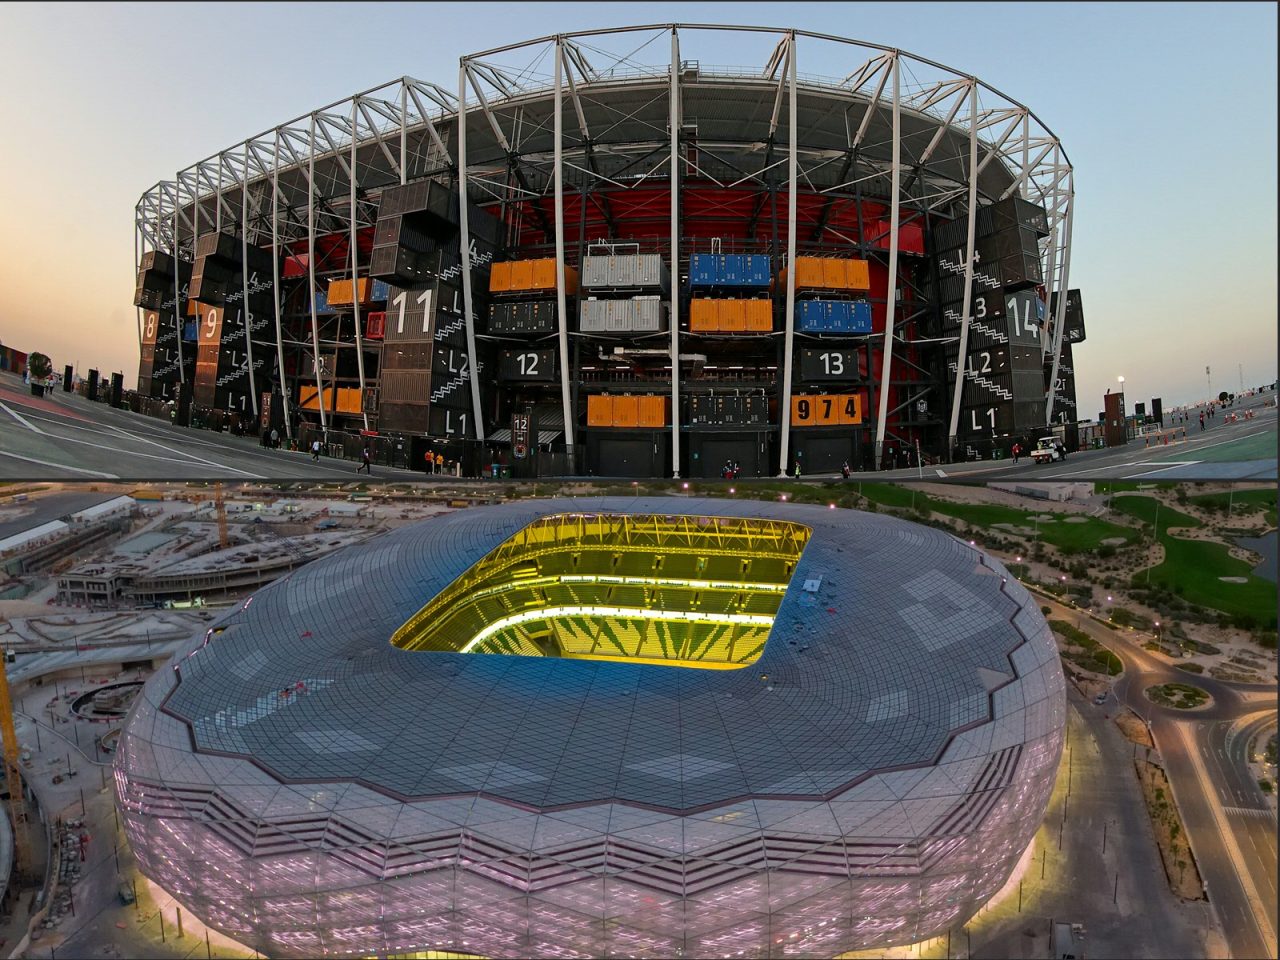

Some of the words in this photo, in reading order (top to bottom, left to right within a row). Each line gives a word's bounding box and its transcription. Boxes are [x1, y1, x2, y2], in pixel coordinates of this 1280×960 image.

[206, 308, 217, 339] 9
[392, 289, 433, 334] 11
[1007, 296, 1039, 339] 14
[146, 313, 155, 339] 8
[164, 348, 181, 366] L2
[231, 350, 249, 369] L2
[449, 349, 469, 377] L2
[516, 352, 539, 376] 12
[819, 352, 845, 376] 13
[967, 351, 993, 377] L2
[228, 391, 247, 412] L1
[445, 409, 467, 436] L1
[514, 419, 528, 430] 12
[970, 407, 996, 431] L1
